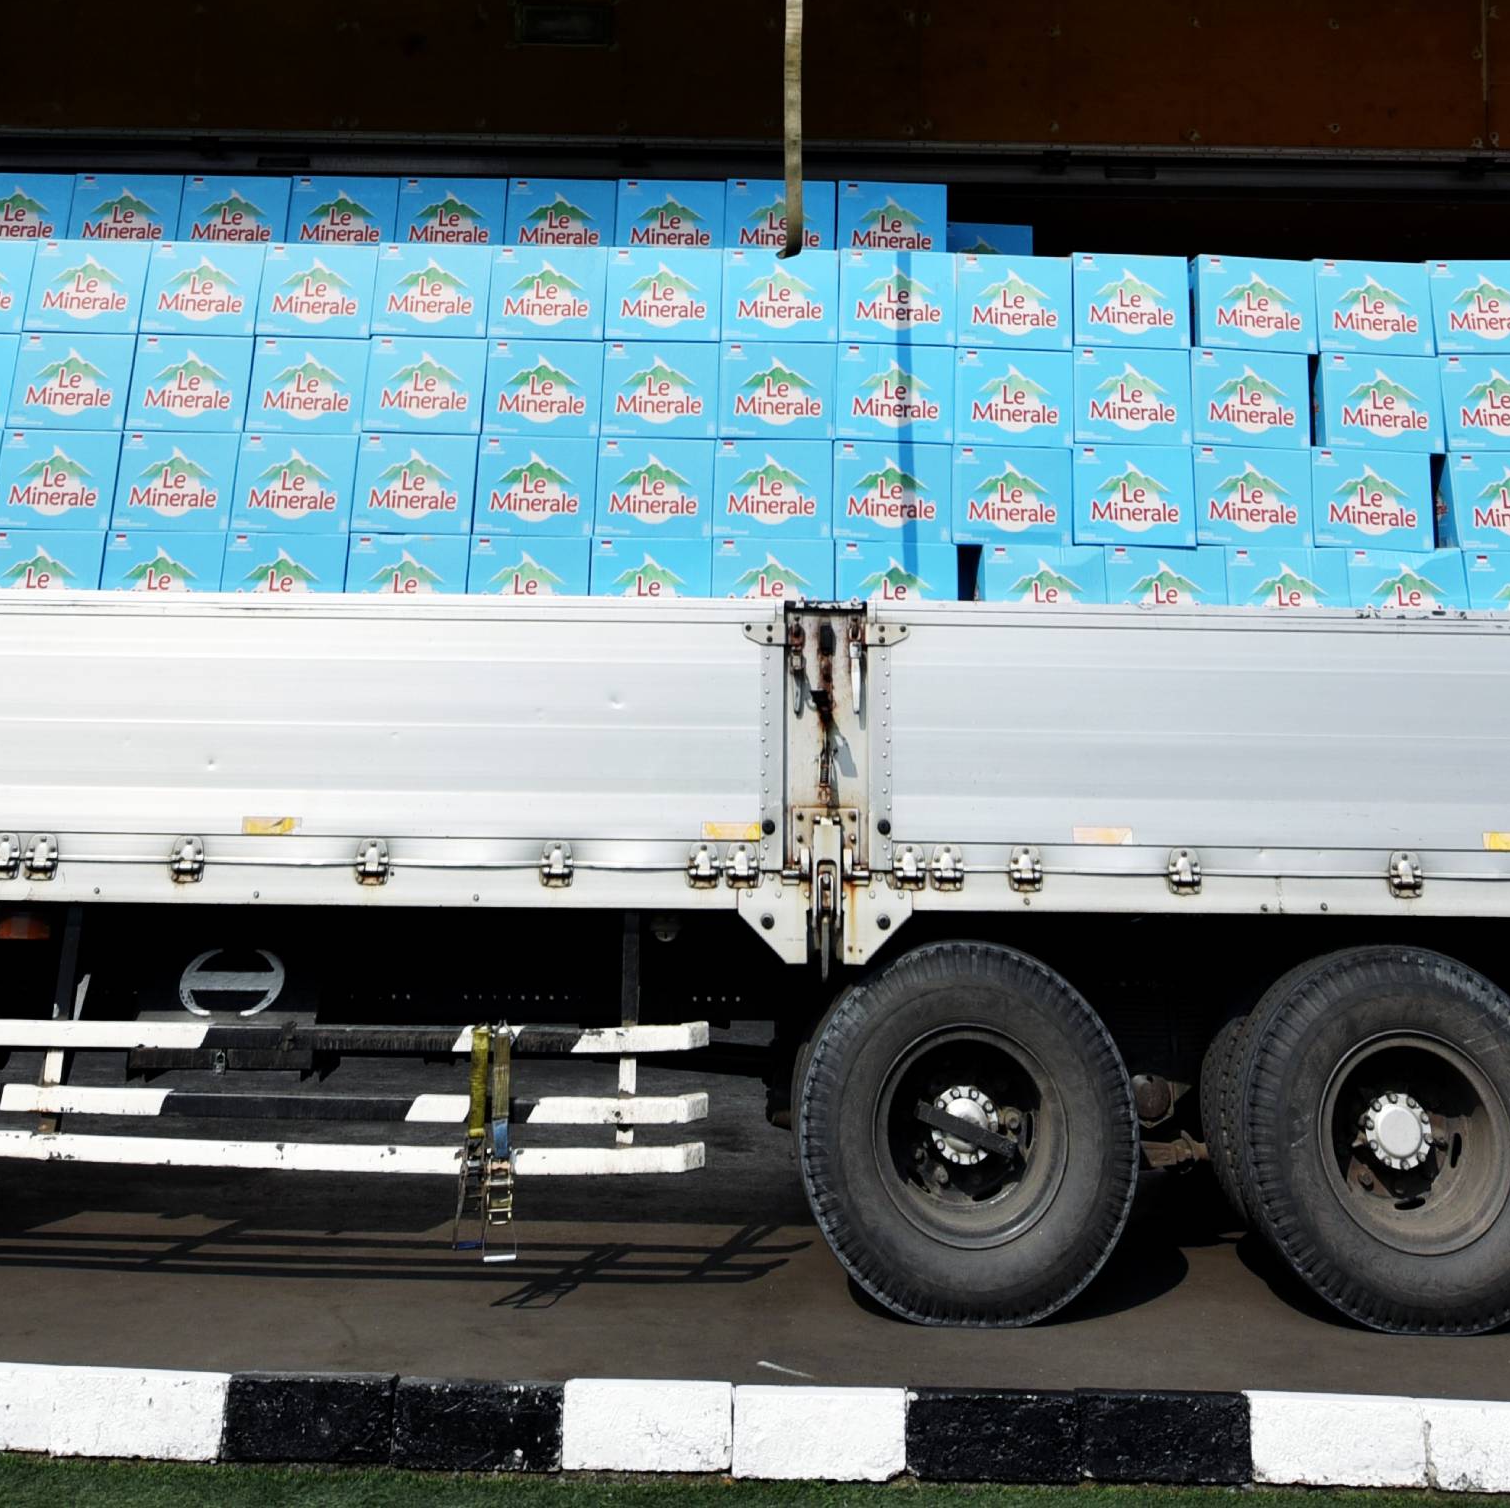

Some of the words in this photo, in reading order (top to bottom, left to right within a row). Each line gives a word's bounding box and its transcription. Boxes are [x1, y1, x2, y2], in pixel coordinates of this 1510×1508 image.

[3, 203, 27, 224] Le
[112, 204, 136, 223] Le
[328, 209, 354, 229] Le
[437, 209, 462, 230] Le
[657, 212, 681, 231] Le
[767, 211, 788, 231] Le
[83, 221, 161, 240] Minerale
[301, 224, 380, 242] Minerale
[409, 225, 488, 243] Minerale
[632, 226, 710, 246] Minerale
[878, 216, 903, 235] Le
[739, 228, 820, 247] Minele
[853, 230, 931, 249] Minerale
[72, 275, 97, 296] Le
[187, 278, 212, 298] Le
[302, 279, 327, 300] Le
[533, 280, 559, 302] Le
[652, 283, 676, 304] Le
[885, 284, 907, 306] Le
[43, 291, 127, 310] Minerale
[158, 293, 242, 312] Minerale
[273, 295, 356, 315] Minerale
[504, 297, 588, 317] Minerale
[621, 299, 705, 319] Minerale
[1001, 289, 1025, 311] Le
[1118, 289, 1142, 310] Le
[1245, 293, 1270, 313] Le
[1360, 295, 1386, 316] Le
[857, 302, 941, 322] Minerale
[972, 306, 1057, 327] Minerale
[1090, 305, 1174, 326] Minerale
[1217, 308, 1300, 330] Minerale
[1334, 311, 1418, 333] Minerale
[176, 373, 202, 394] Le
[293, 374, 320, 395] Le
[412, 373, 438, 393] Le
[529, 376, 554, 399] Le
[764, 378, 789, 400] Le
[882, 379, 907, 403] Le
[144, 389, 231, 409] Minerale
[264, 390, 349, 412] Minerale
[381, 388, 467, 409] Minerale
[498, 394, 585, 415] Minerale
[735, 395, 821, 416] Minerale
[1001, 386, 1027, 406] Le
[1237, 385, 1264, 406] Le
[1370, 390, 1396, 412] Le
[853, 398, 939, 419] Minerale
[972, 402, 1058, 424] Minerale
[1210, 405, 1294, 426] Minerale
[1343, 407, 1428, 429] Minerale
[42, 467, 69, 490] Le
[160, 468, 188, 492] Le
[400, 471, 425, 494] Le
[521, 473, 546, 496] Le
[640, 475, 666, 498] Le
[757, 476, 782, 499] Le
[9, 485, 97, 506] Minerale
[129, 487, 217, 508] Minerale
[369, 489, 457, 511] Minerale
[490, 491, 578, 513] Minerale
[610, 493, 697, 514] Minerale
[997, 483, 1024, 506] Le
[1120, 482, 1146, 505] Le
[1238, 483, 1264, 505] Le
[1357, 486, 1382, 508] Le
[727, 494, 815, 515] Minerale
[968, 501, 1056, 524] Minerale
[1092, 500, 1179, 523] Minerale
[1210, 501, 1297, 524] Minerale
[1329, 506, 1417, 528] Minerale
[146, 570, 172, 592] Le
[267, 571, 294, 593] Le
[513, 575, 537, 596] Le
[759, 576, 784, 599] Le
[882, 580, 908, 602] Le
[1153, 583, 1180, 605] Le
